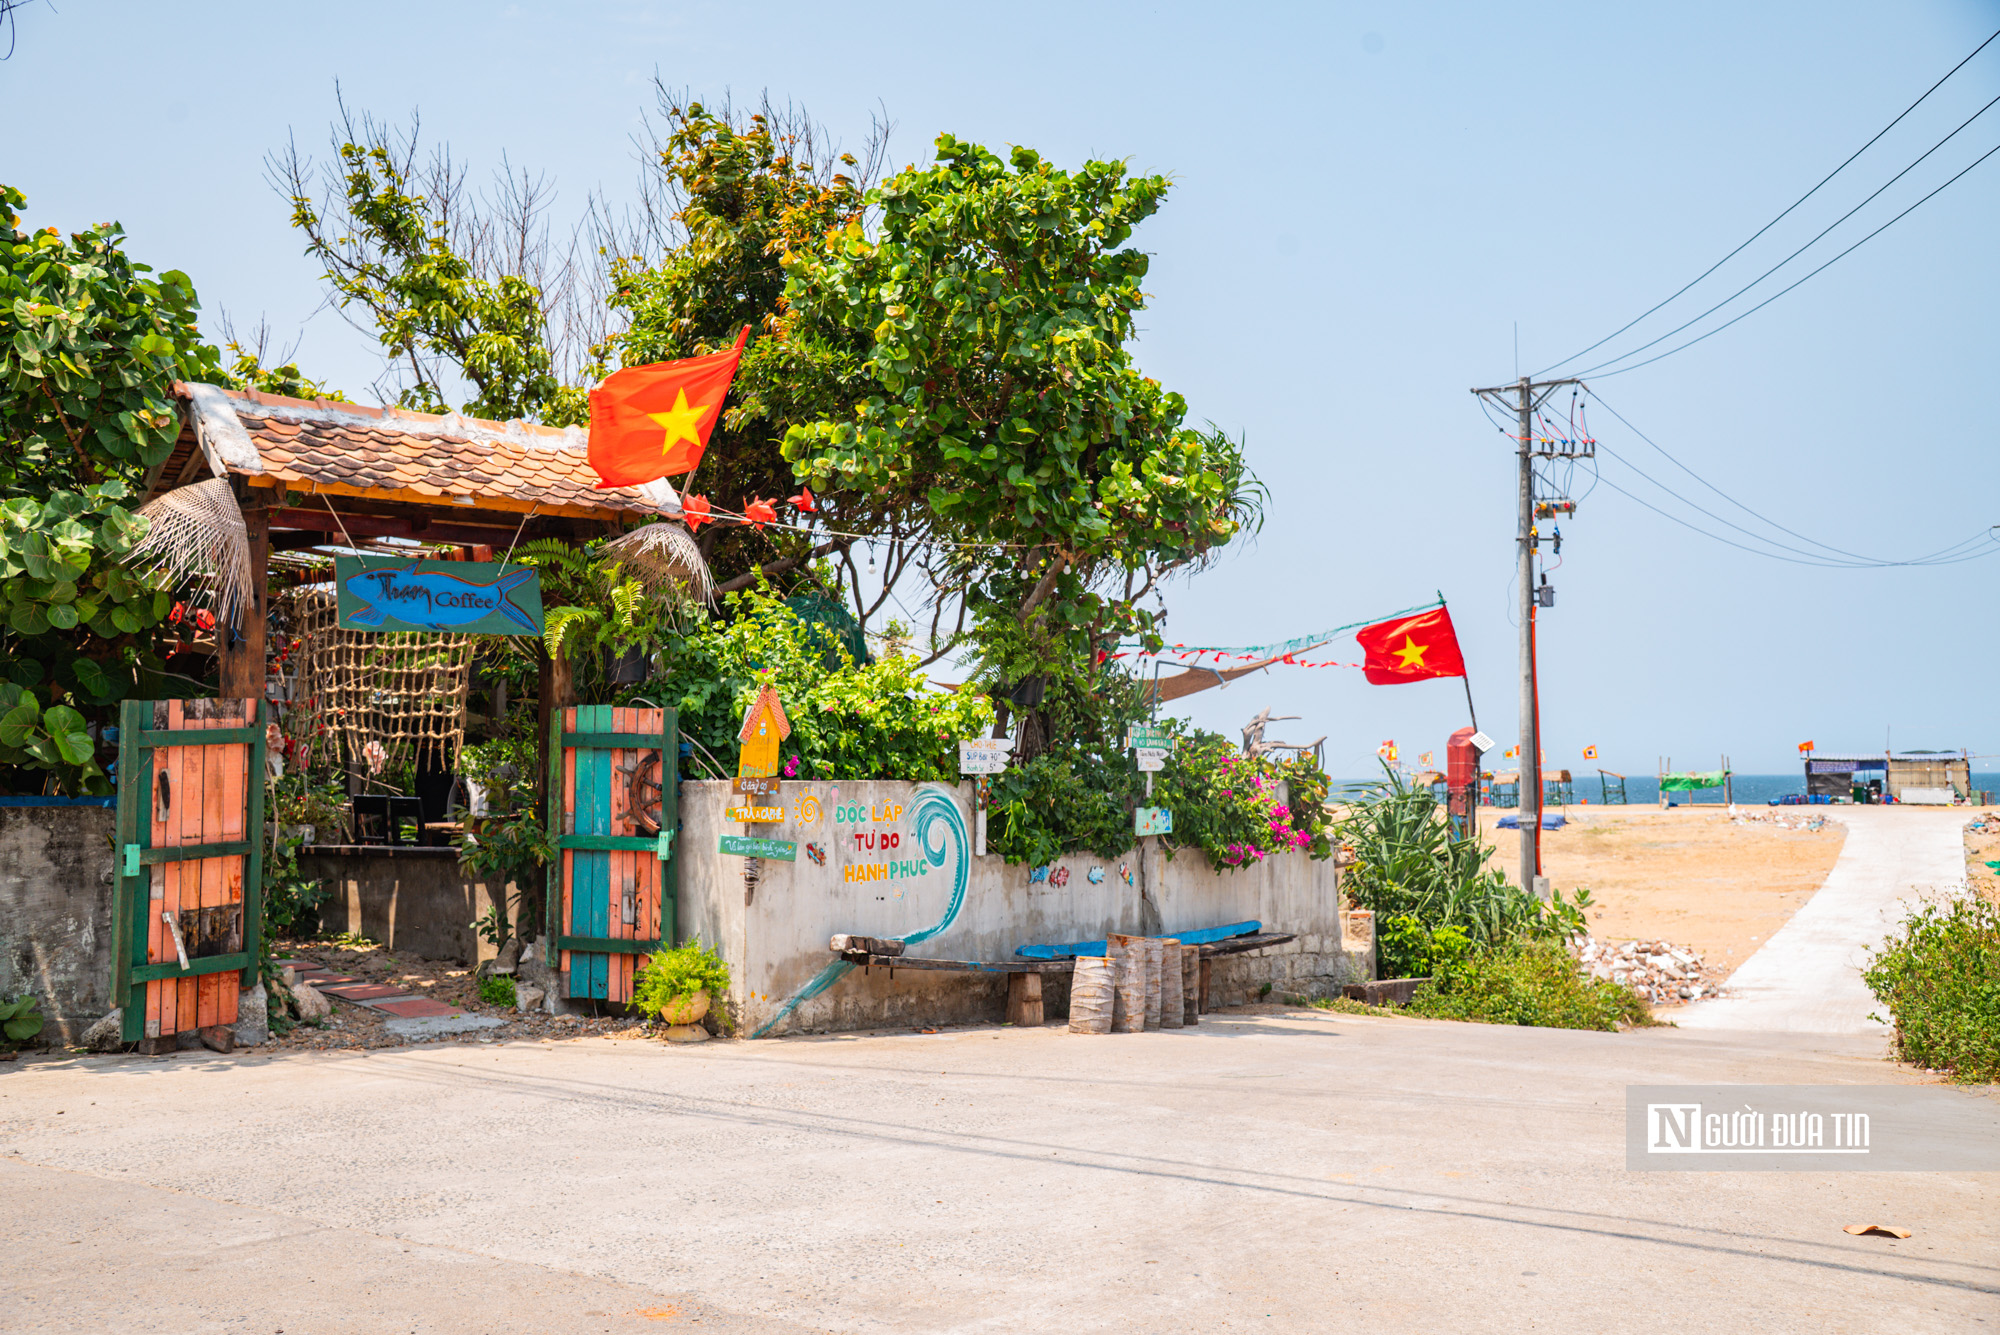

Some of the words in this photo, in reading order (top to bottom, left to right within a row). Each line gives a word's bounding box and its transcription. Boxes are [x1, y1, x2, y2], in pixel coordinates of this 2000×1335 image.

[435, 591, 494, 609] Coffee
[966, 751, 978, 760] SUP
[760, 780, 769, 790] có
[836, 799, 867, 829] ĐỘC
[872, 798, 903, 828] LẬP
[854, 829, 876, 856] TỰ
[880, 832, 900, 850] DO
[844, 863, 888, 885] HẠNH
